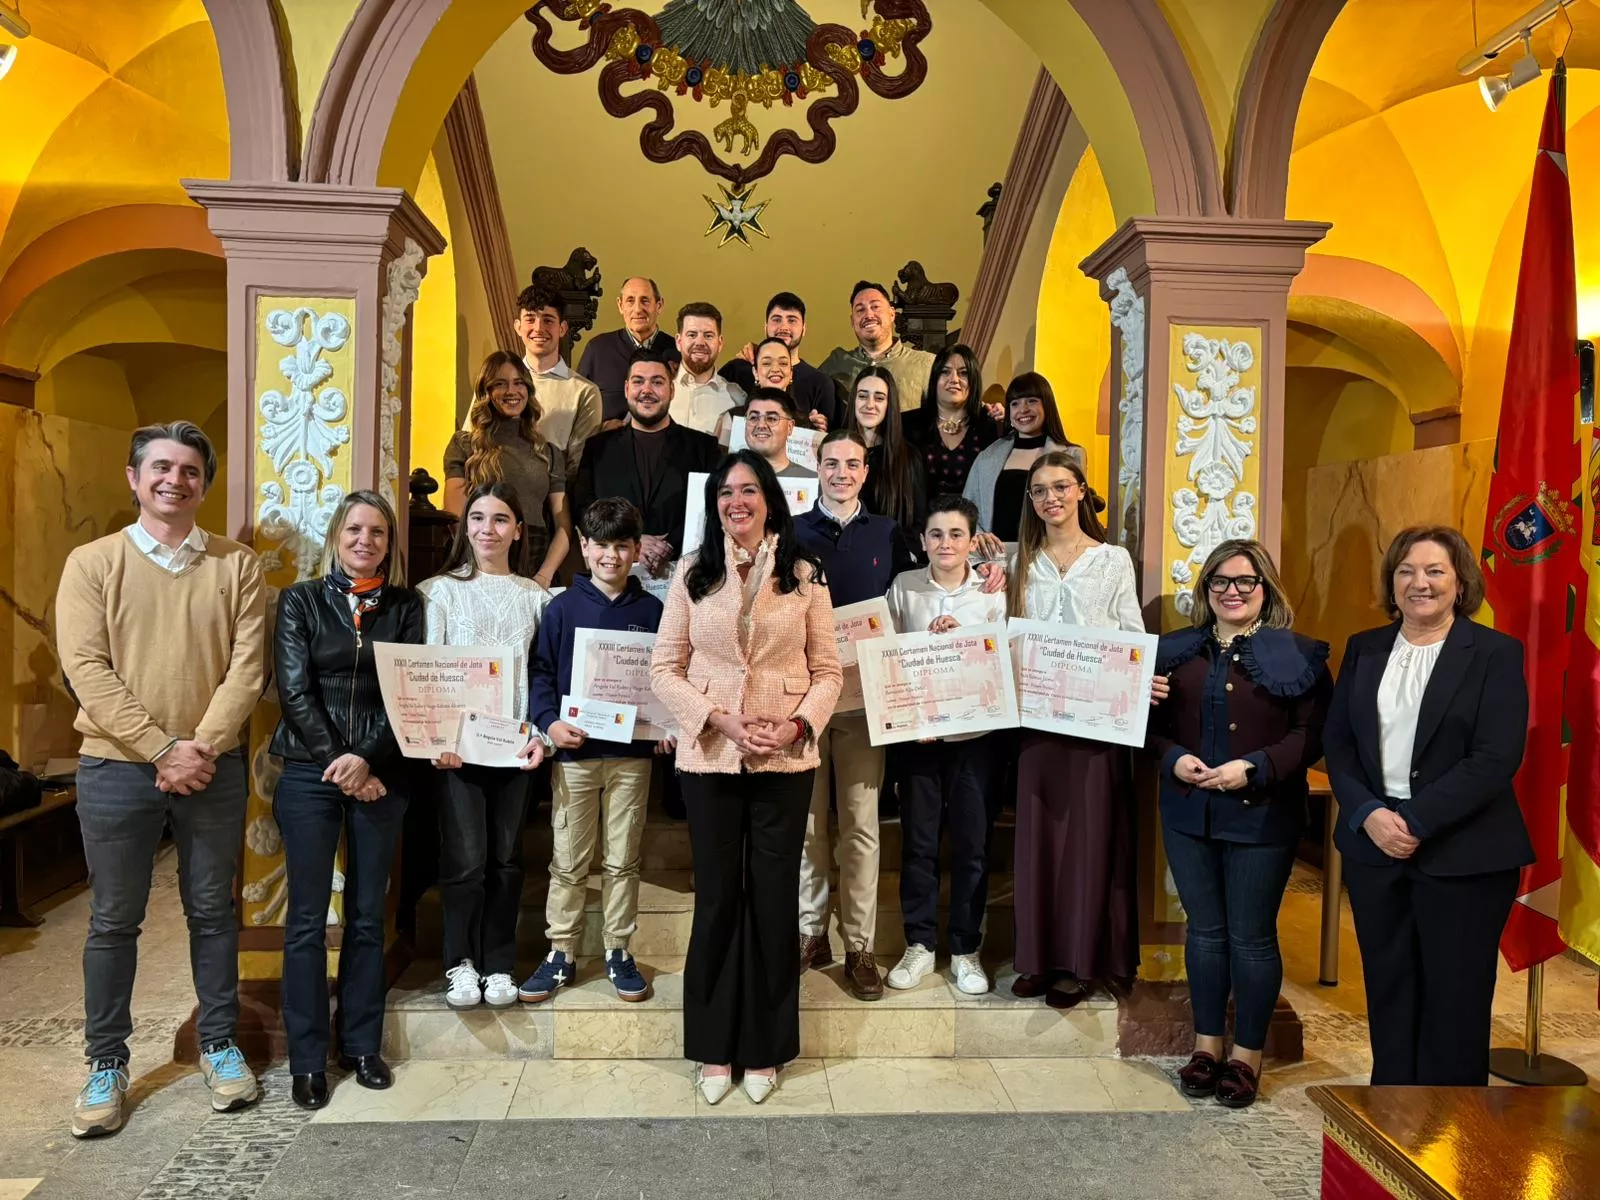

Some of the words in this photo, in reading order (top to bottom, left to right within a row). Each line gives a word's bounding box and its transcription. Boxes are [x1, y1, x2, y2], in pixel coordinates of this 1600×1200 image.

[616, 643, 645, 653] Certamen
[899, 647, 928, 657] Certamen
[928, 641, 954, 652] Nacional
[955, 641, 964, 649] de
[963, 639, 978, 648] Jota
[1044, 634, 1072, 646] Certamen
[1072, 639, 1099, 650] Nacional
[1100, 643, 1108, 652] de
[1108, 643, 1124, 654] Jota
[613, 654, 639, 666] "Ciudad
[640, 658, 649, 667] de
[898, 656, 925, 669] "Ciudad
[925, 655, 935, 665] de
[935, 651, 964, 664] Huesca"
[1039, 646, 1065, 659] "Ciudad
[1066, 649, 1075, 660] de
[1076, 650, 1107, 664] Huesca"
[408, 659, 435, 669] Certamen
[435, 660, 459, 669] Nacional
[459, 660, 468, 669] de
[469, 660, 483, 669] Jota
[1050, 661, 1092, 673] DIPLOMA
[430, 673, 438, 682] de
[439, 672, 468, 682] Huesca"
[913, 666, 955, 678] DIPLOMA
[418, 686, 456, 694] DIPLOMA
